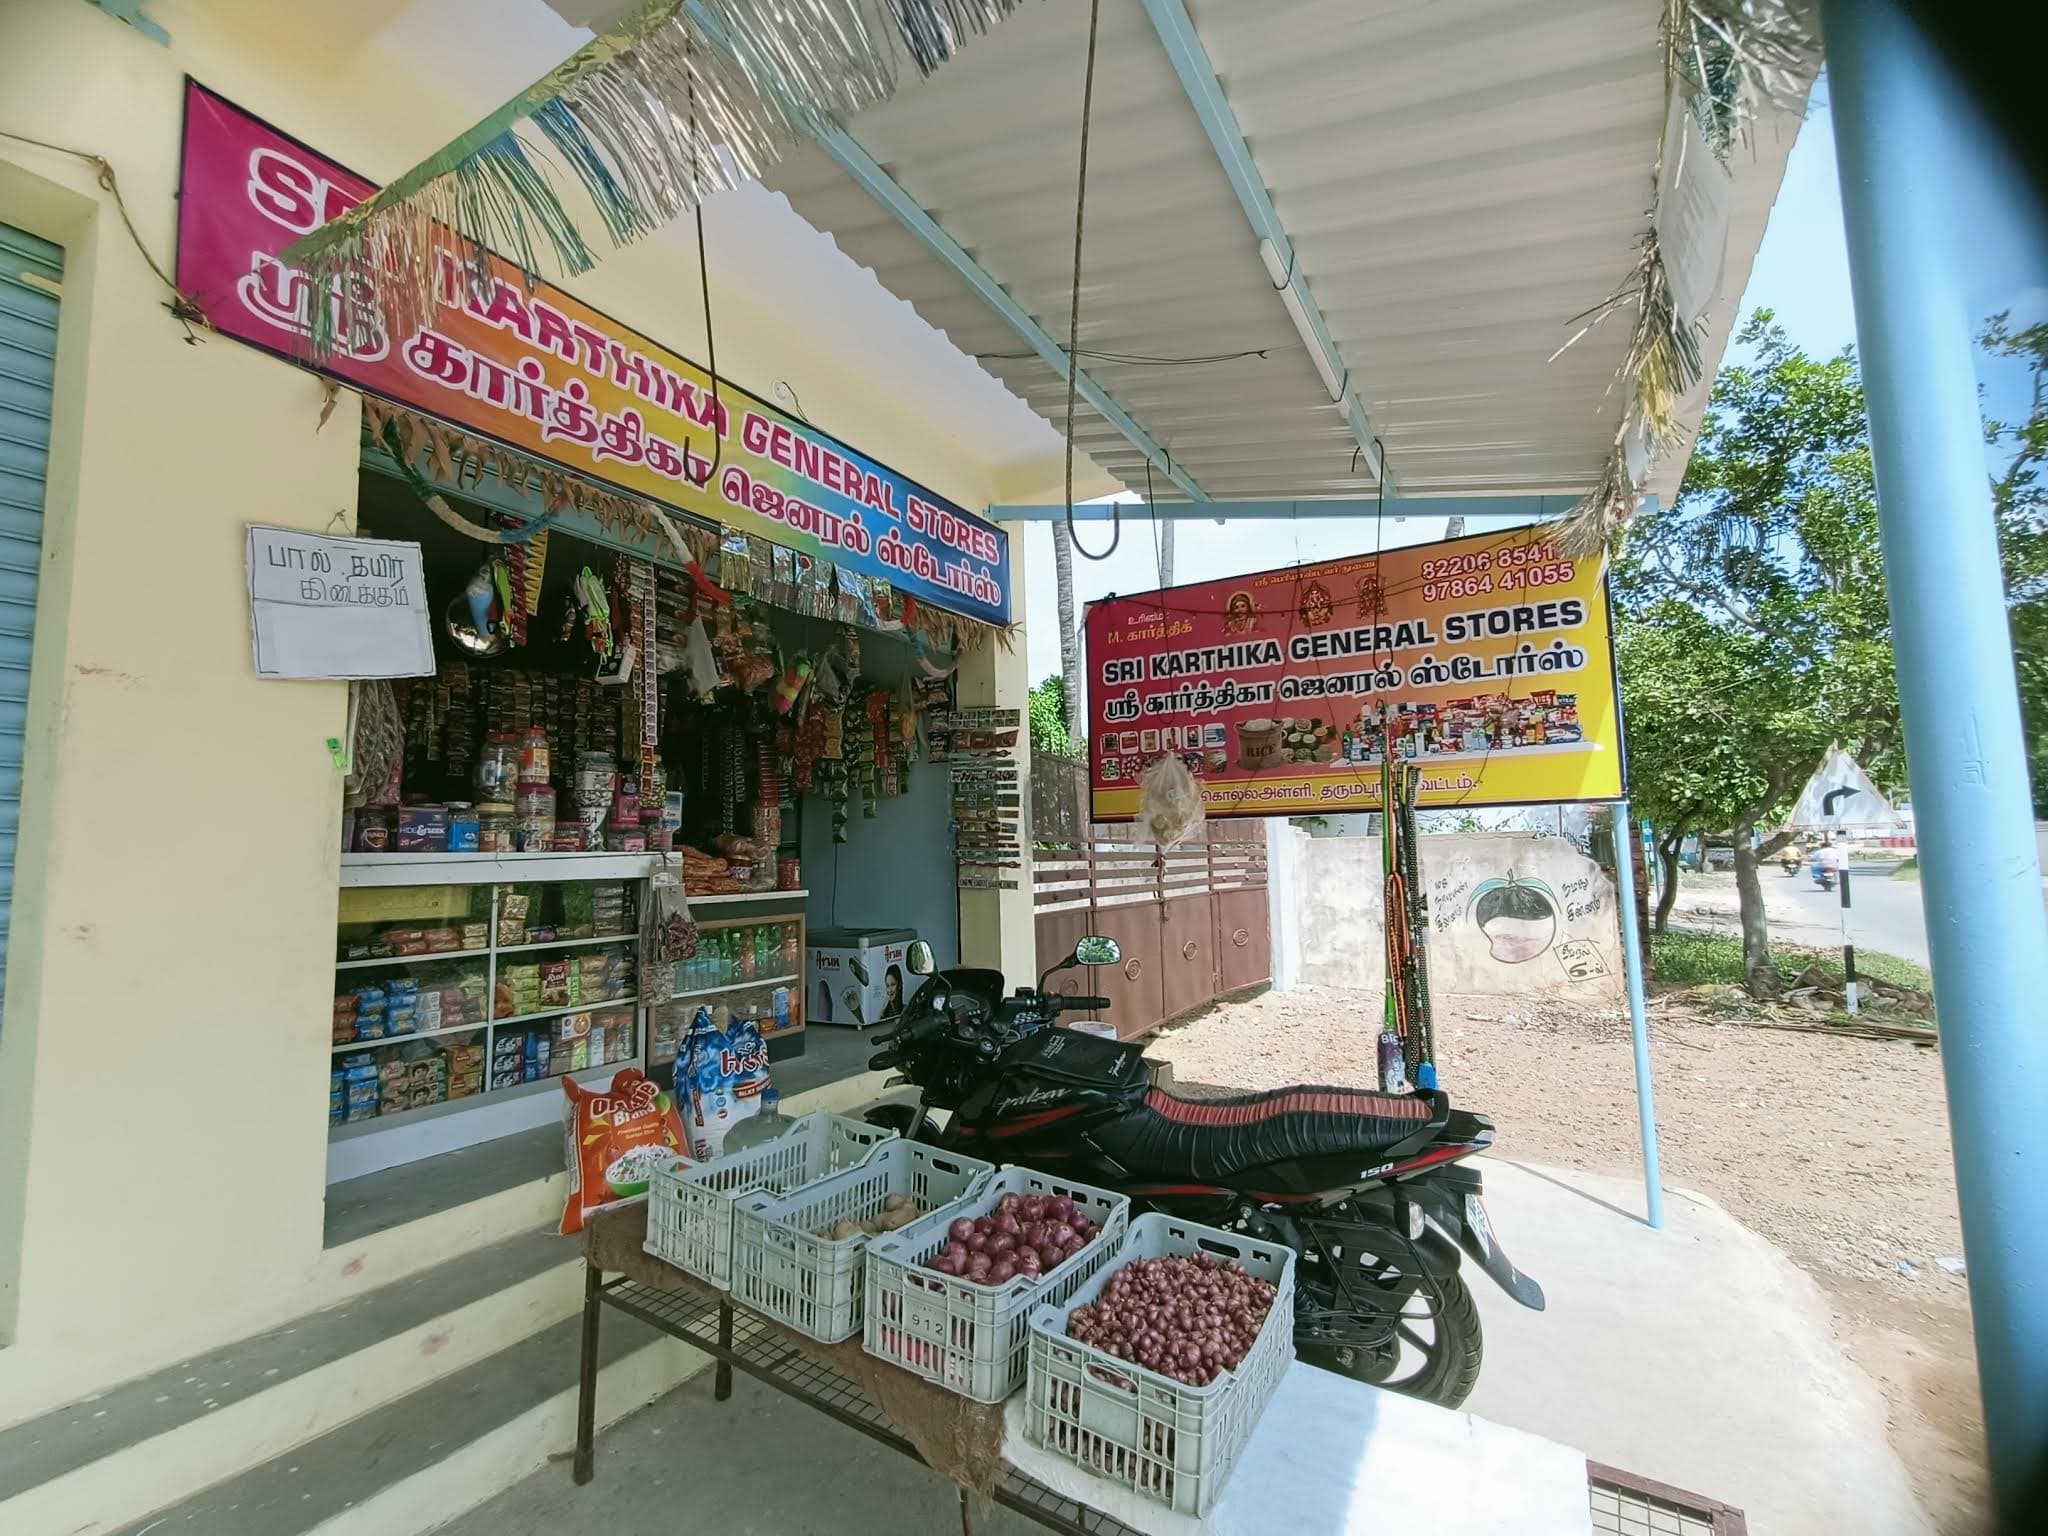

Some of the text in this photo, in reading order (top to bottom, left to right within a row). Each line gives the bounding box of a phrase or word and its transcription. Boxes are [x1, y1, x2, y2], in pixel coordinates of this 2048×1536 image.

[435, 247, 729, 438] KARTHIKA
[742, 412, 902, 520] GENERAL
[906, 498, 1000, 566] STORES
[403, 326, 712, 490] கார்த்திகா
[720, 466, 871, 556] ஜெனரல்
[877, 529, 1001, 606] ஸ்டோர்ஸ்
[1422, 542, 1560, 579] 82206 8541
[1423, 562, 1575, 602] 97864 41055
[1105, 600, 1582, 683] SRI KARTHIKA GENERAL STORES
[1106, 641, 1583, 721] ஸ்ரீ கார்த்திகா ஜெனரல் ஸ்டோர்ஸ்
[1320, 782, 1384, 801] தருமபு
[1360, 1162, 1394, 1179] 150
